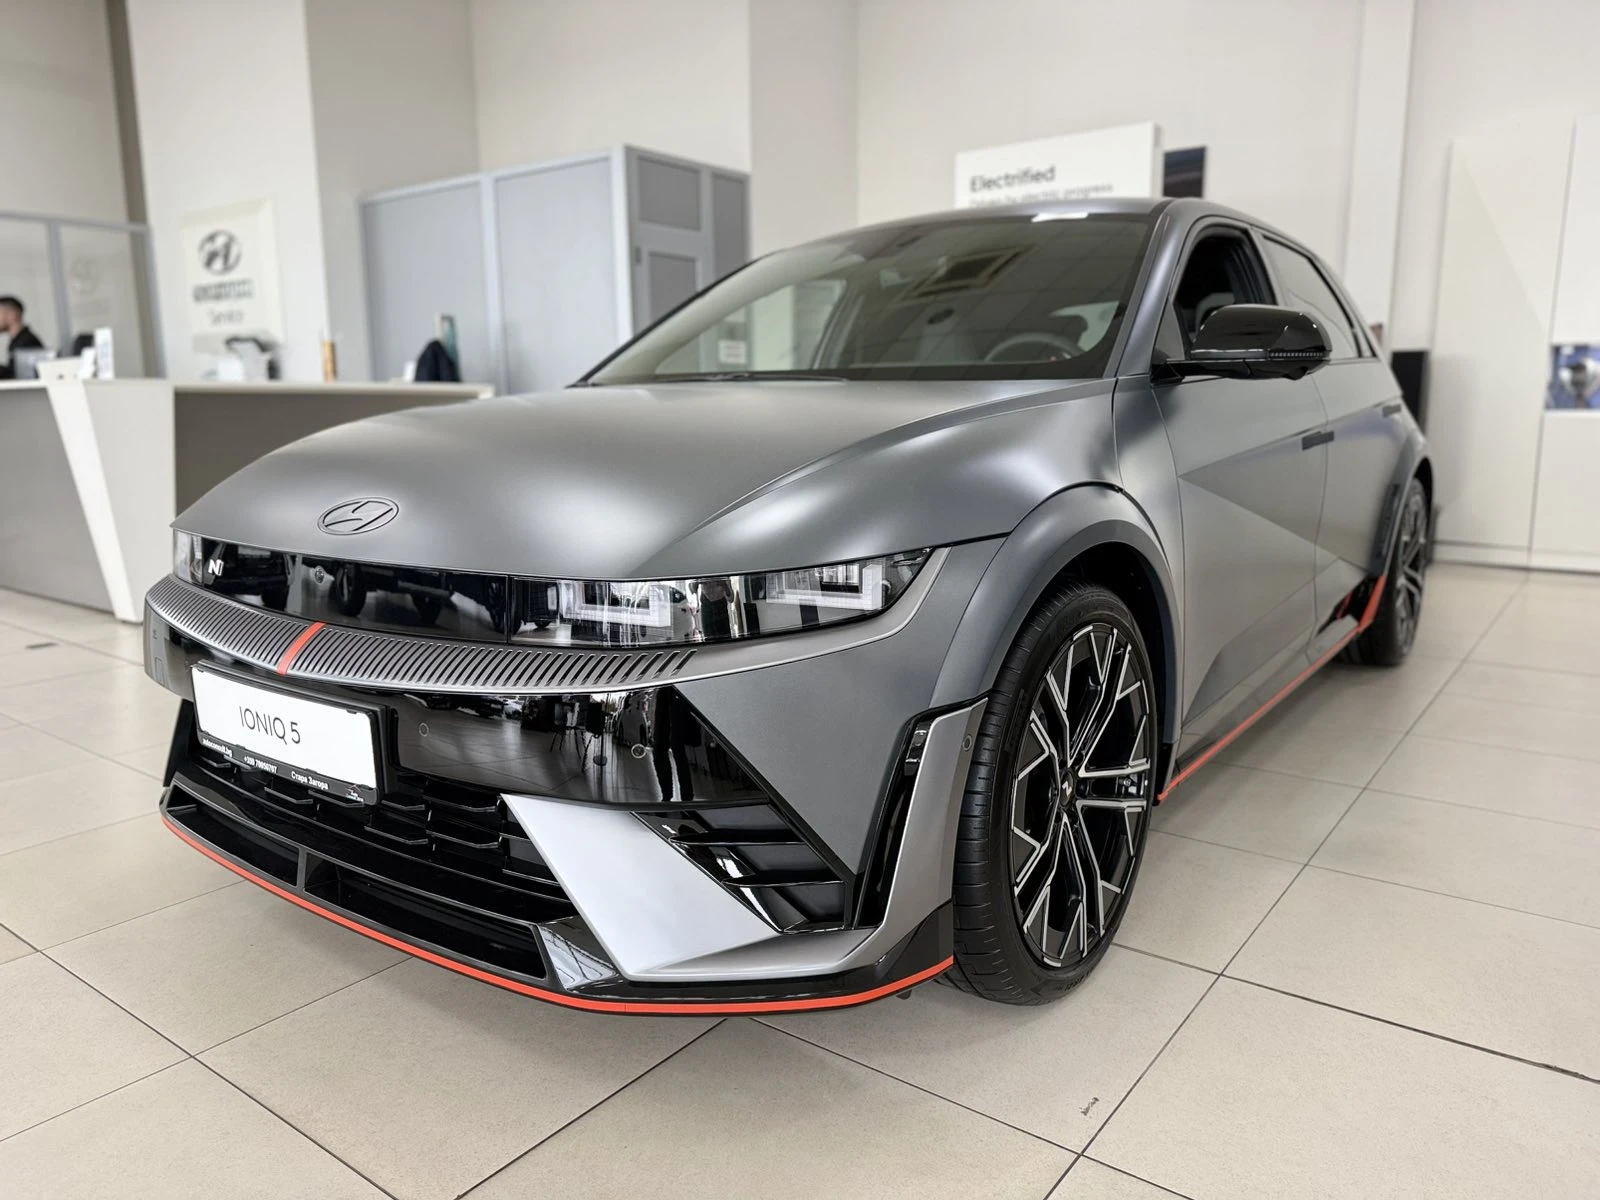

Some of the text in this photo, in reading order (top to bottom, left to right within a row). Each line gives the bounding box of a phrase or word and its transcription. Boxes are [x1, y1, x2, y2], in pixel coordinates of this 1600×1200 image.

[970, 165, 1056, 193] Electrified
[239, 705, 301, 745] IONIQ 5
[291, 770, 329, 790] Стара Загора
